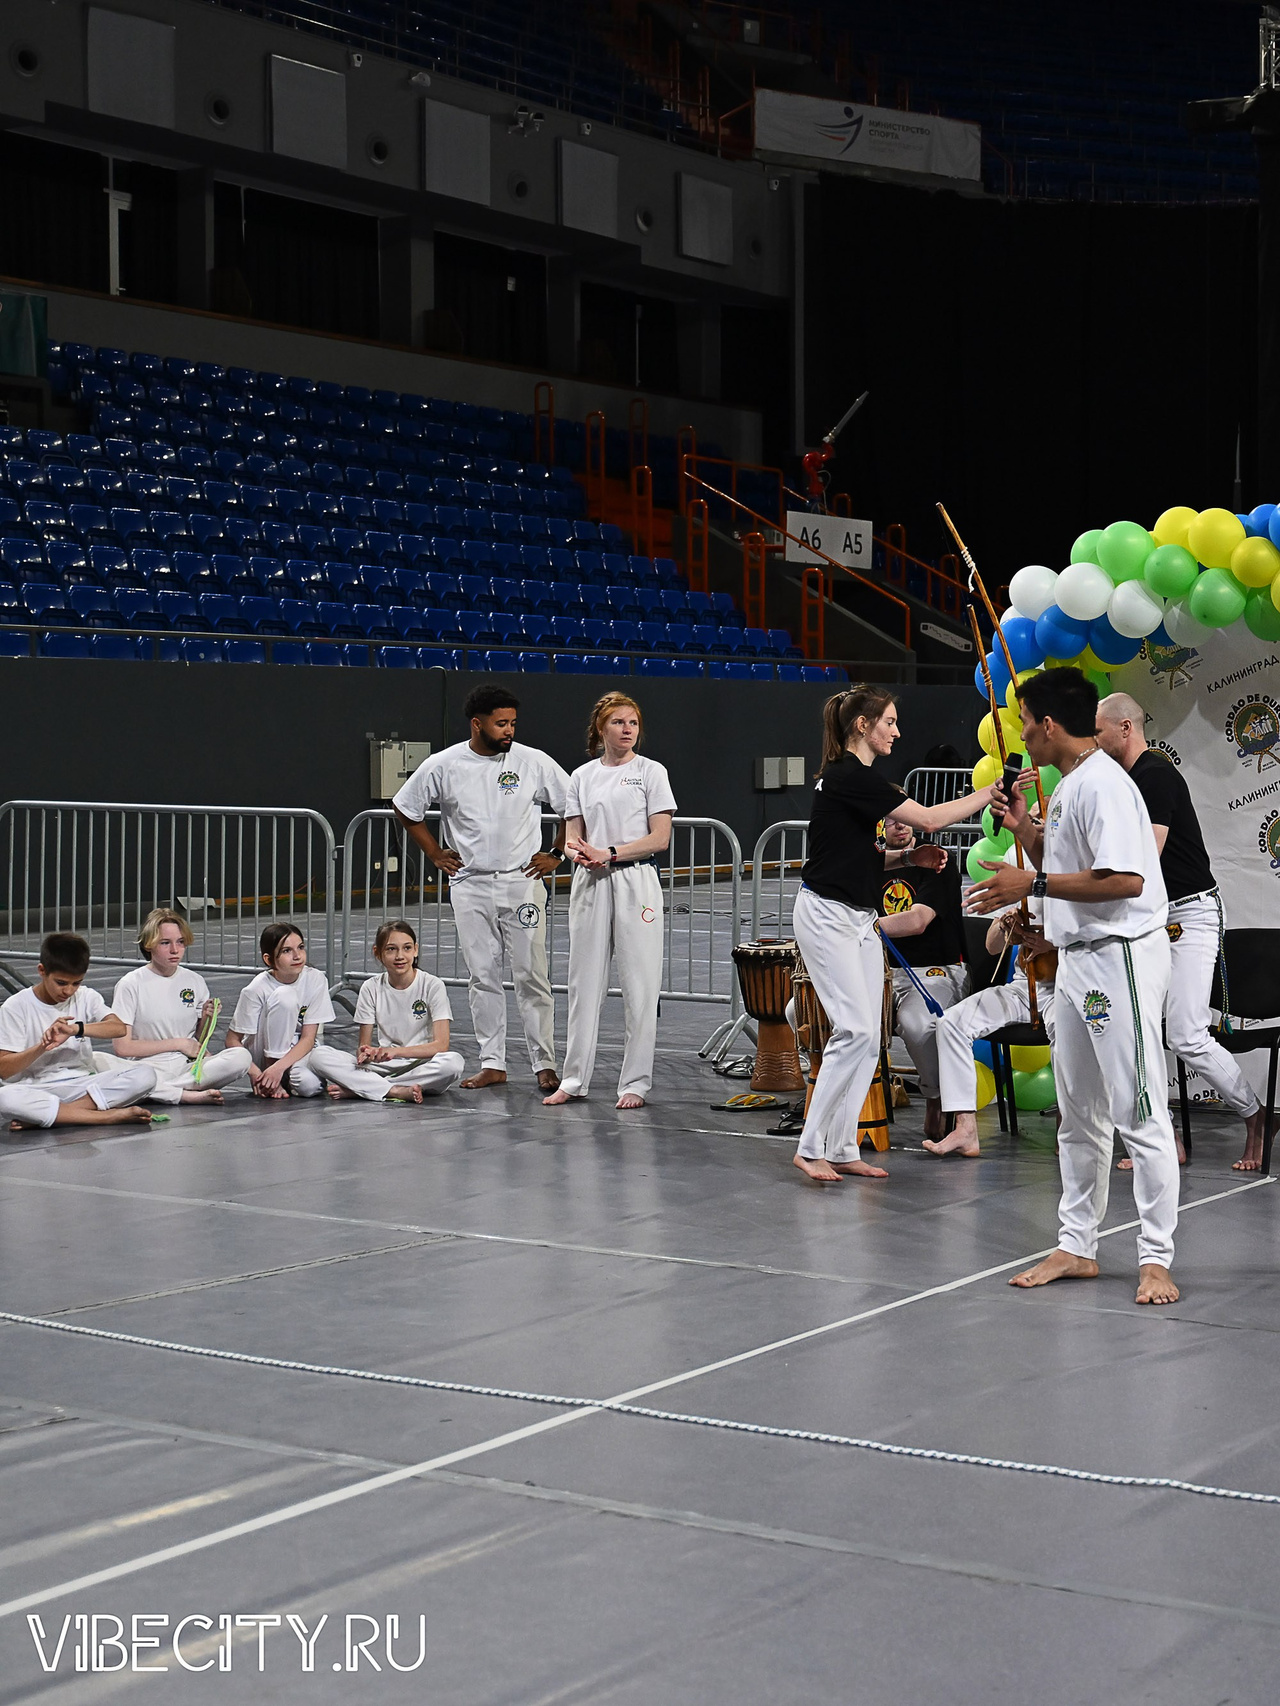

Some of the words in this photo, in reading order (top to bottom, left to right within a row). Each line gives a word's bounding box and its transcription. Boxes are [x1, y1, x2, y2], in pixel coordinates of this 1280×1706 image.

[869, 120, 930, 136] МИНИСТЕРСТВО
[869, 129, 900, 140] СПОРТА
[1206, 654, 1280, 694] КАЛИНИНГРАД
[1225, 699, 1246, 743] CORDÃO
[1247, 693, 1260, 703] DE
[1159, 741, 1181, 765] OURO
[1258, 809, 1279, 853] CORDÃO
